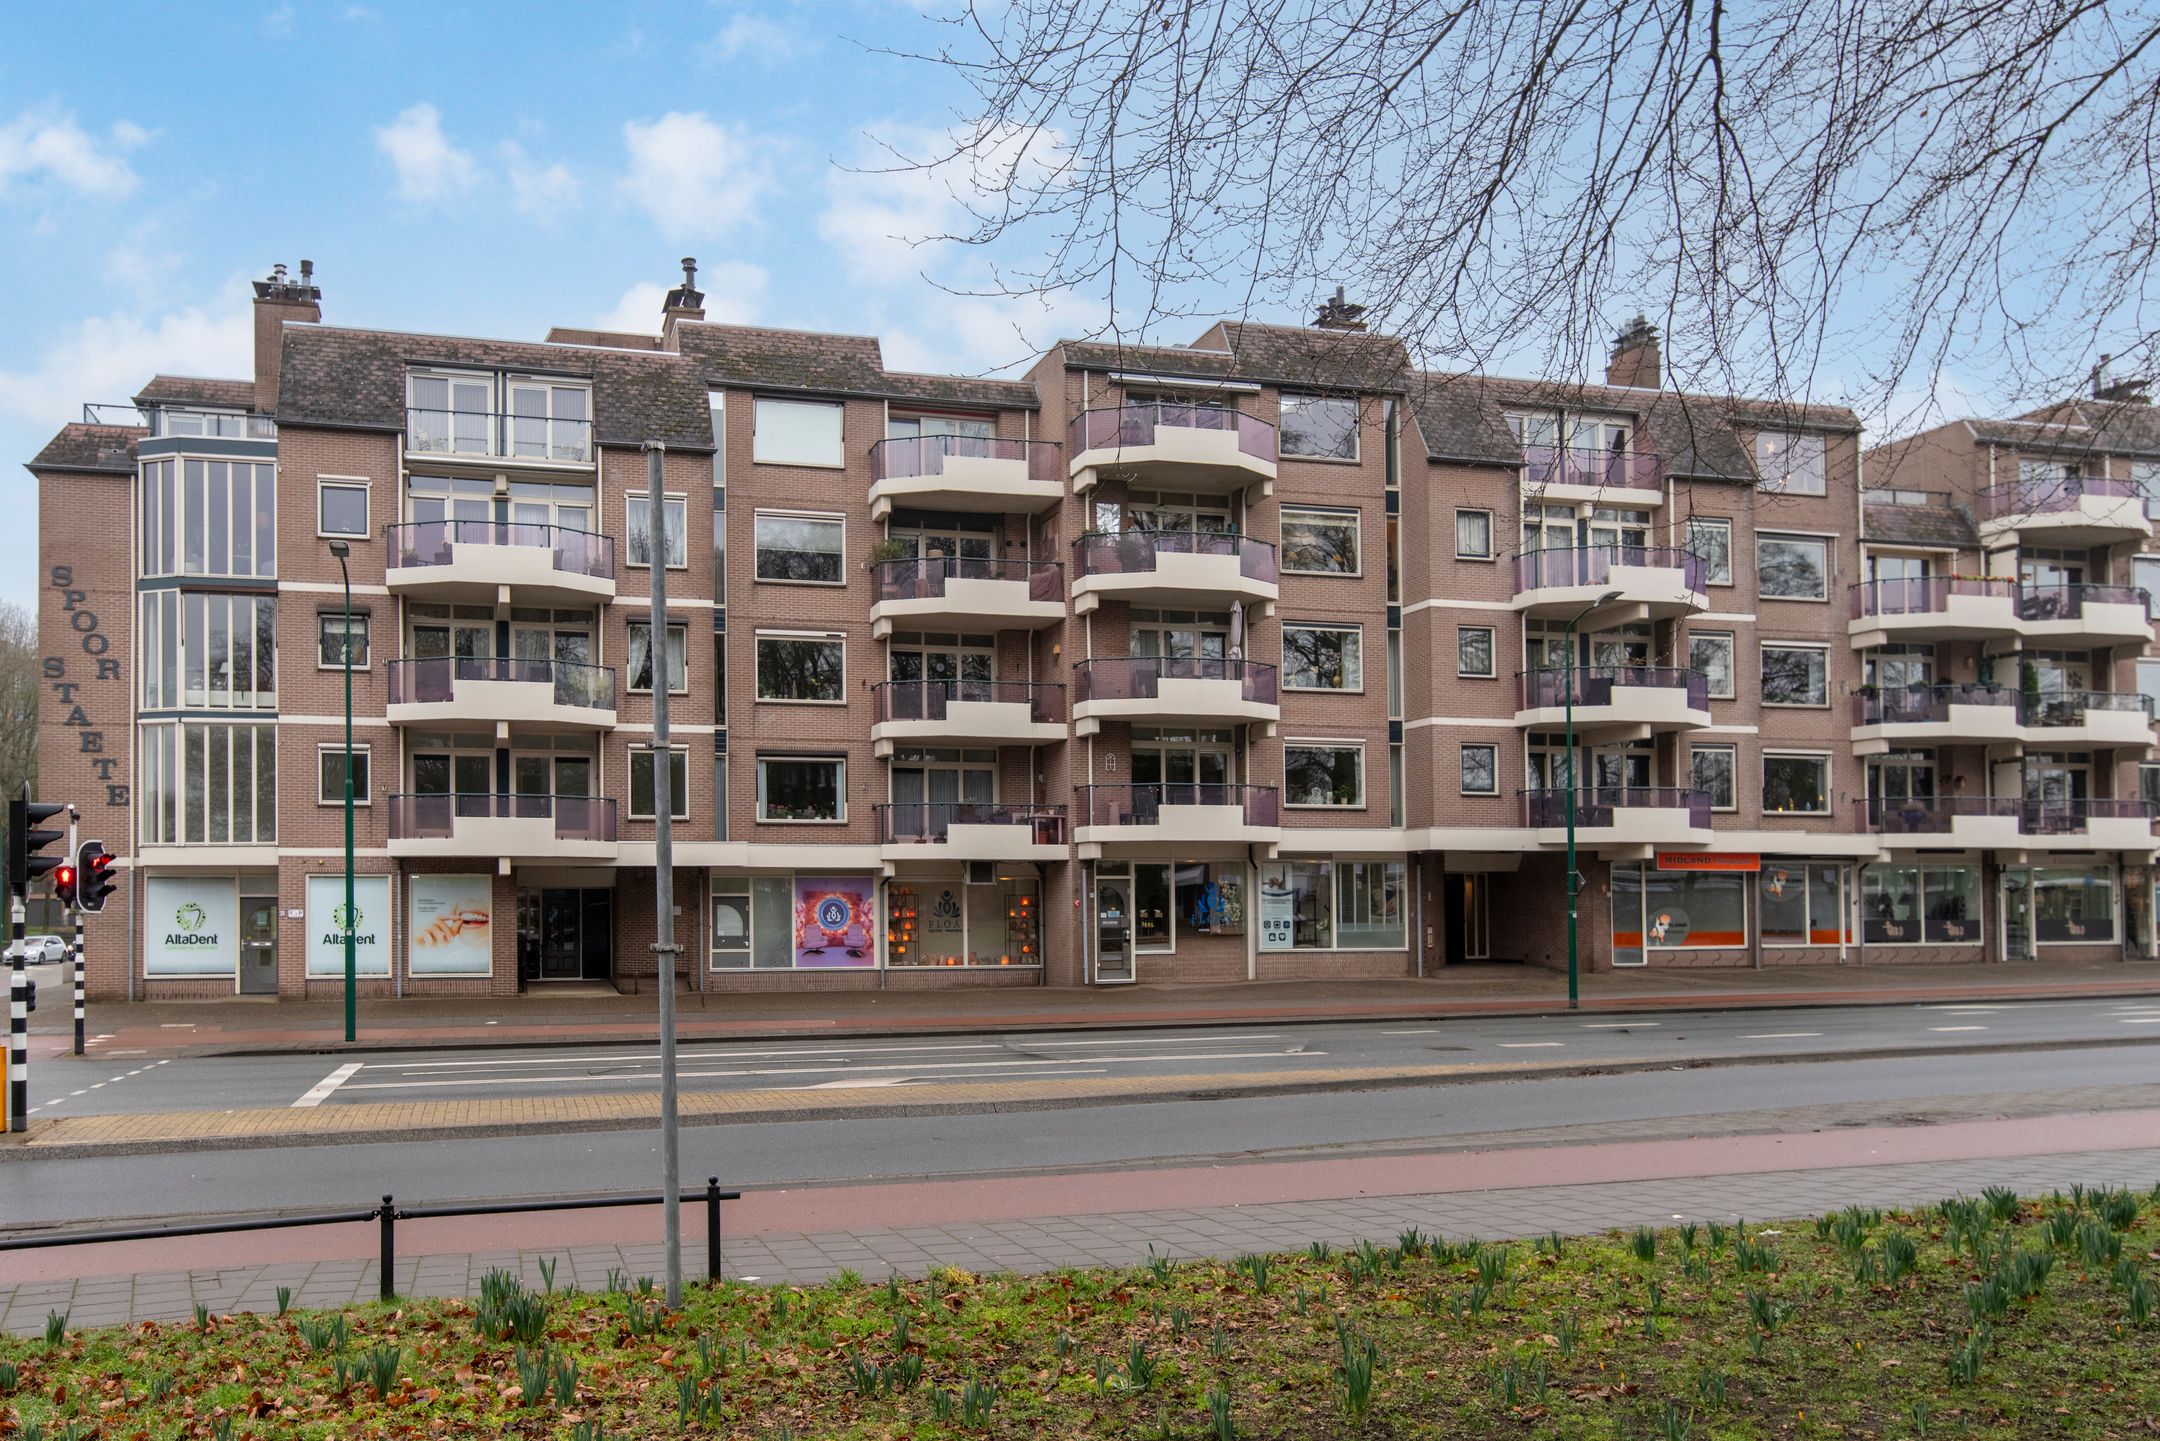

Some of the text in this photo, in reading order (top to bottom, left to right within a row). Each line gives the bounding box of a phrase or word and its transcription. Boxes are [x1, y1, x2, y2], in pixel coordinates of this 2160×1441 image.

[51, 565, 120, 680] SPOOR
[43, 656, 130, 806] STAETE
[1664, 856, 1712, 865] MIDLAND
[165, 933, 218, 945] AltaDent
[322, 933, 376, 945] Altaent
